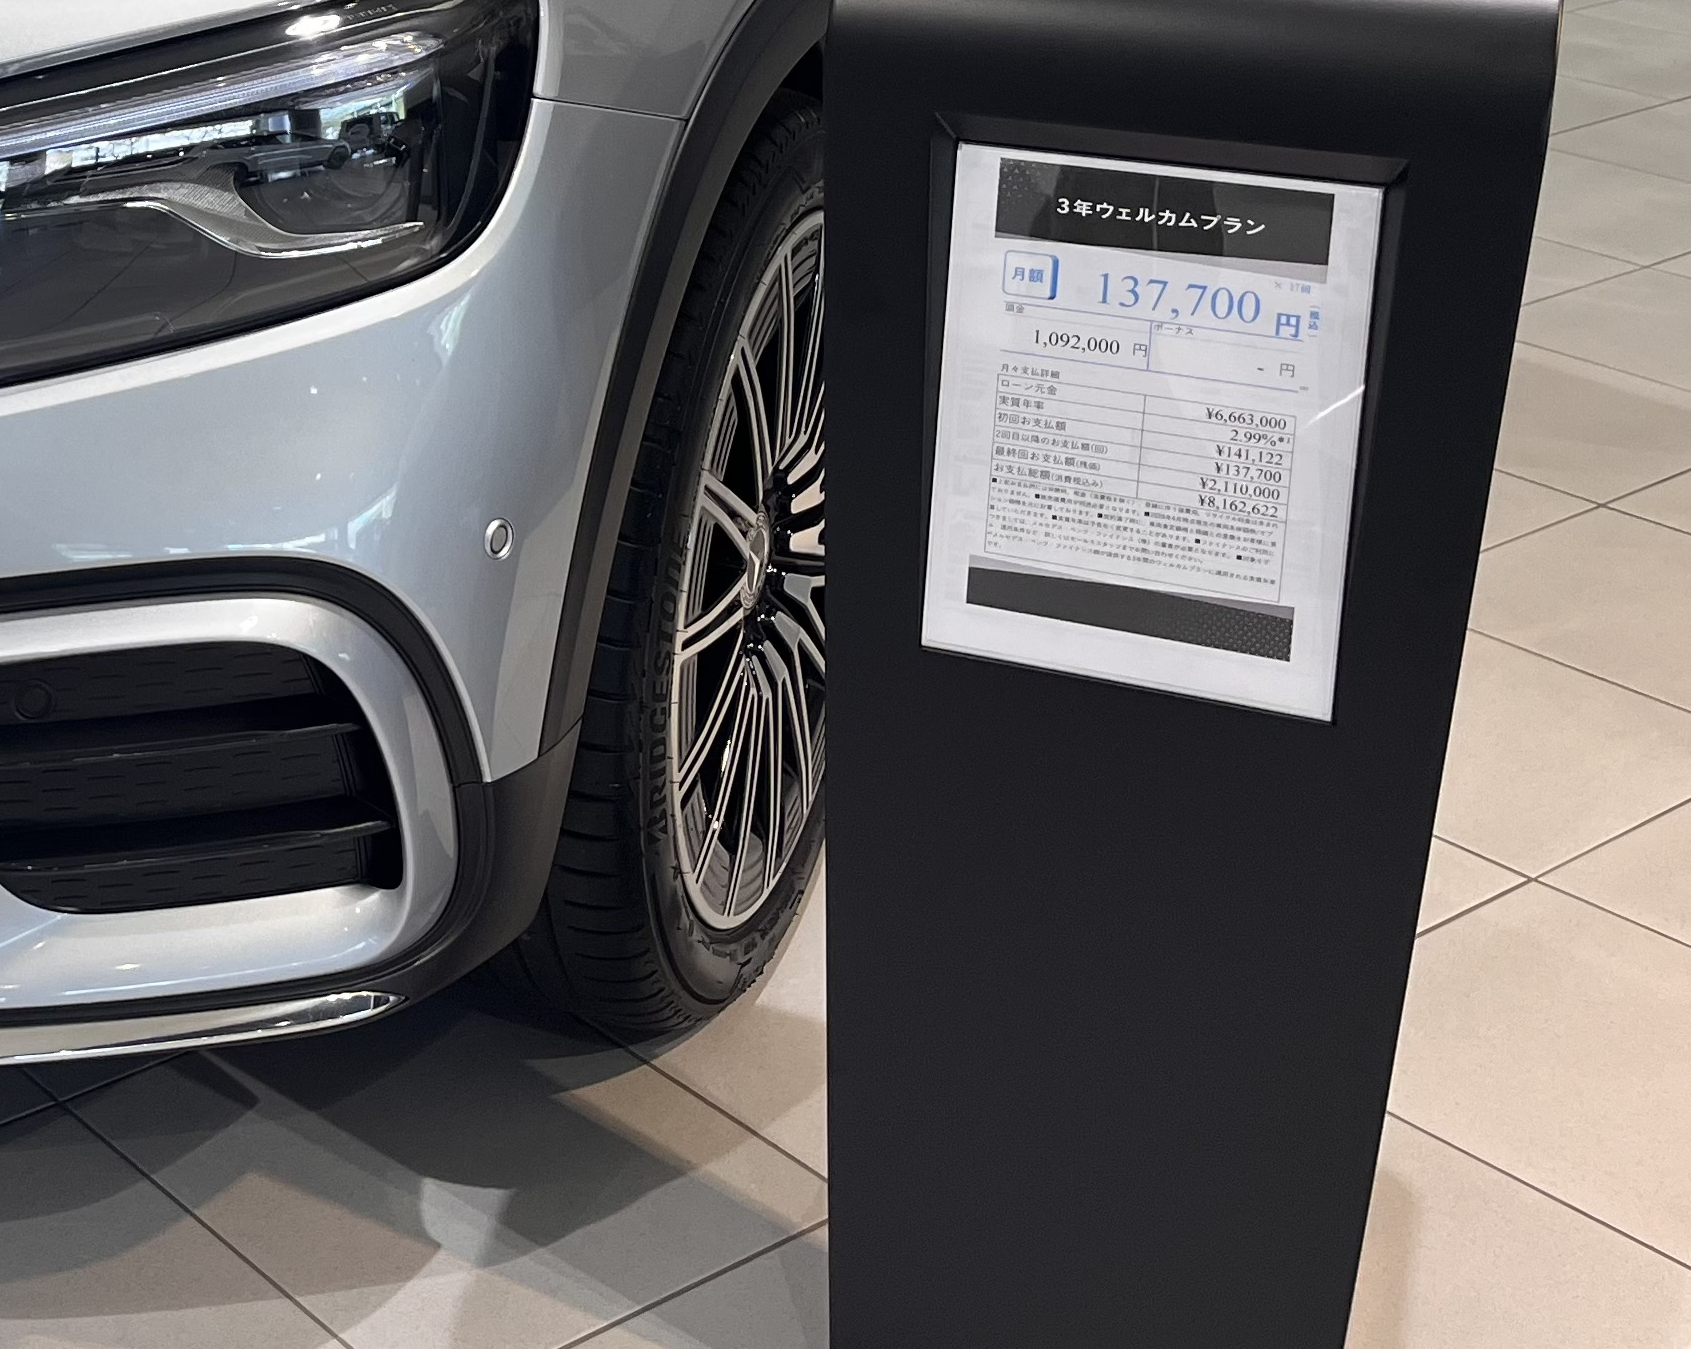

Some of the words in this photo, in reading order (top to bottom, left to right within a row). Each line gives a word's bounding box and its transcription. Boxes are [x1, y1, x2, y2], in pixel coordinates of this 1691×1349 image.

[1056, 198, 1266, 235] 3年ウェルカムプラン
[1012, 266, 1044, 284] 月額
[1096, 272, 1261, 324] 137,700
[1275, 312, 1302, 339] 円
[1034, 329, 1121, 355] 1,092,000
[1132, 342, 1149, 358] 円
[1279, 363, 1296, 379] 円
[1001, 379, 1058, 396] ローン元金
[997, 411, 1067, 432] 初回お支払額
[1205, 406, 1287, 431] ¥6,663,000
[1215, 444, 1283, 466] ¥141,122
[1214, 461, 1282, 484] ¥137,700
[1200, 476, 1281, 501] ¥2,110,000
[1198, 494, 1278, 519] ¥8,162,622
[647, 525, 688, 846] BRIDGESTONE
